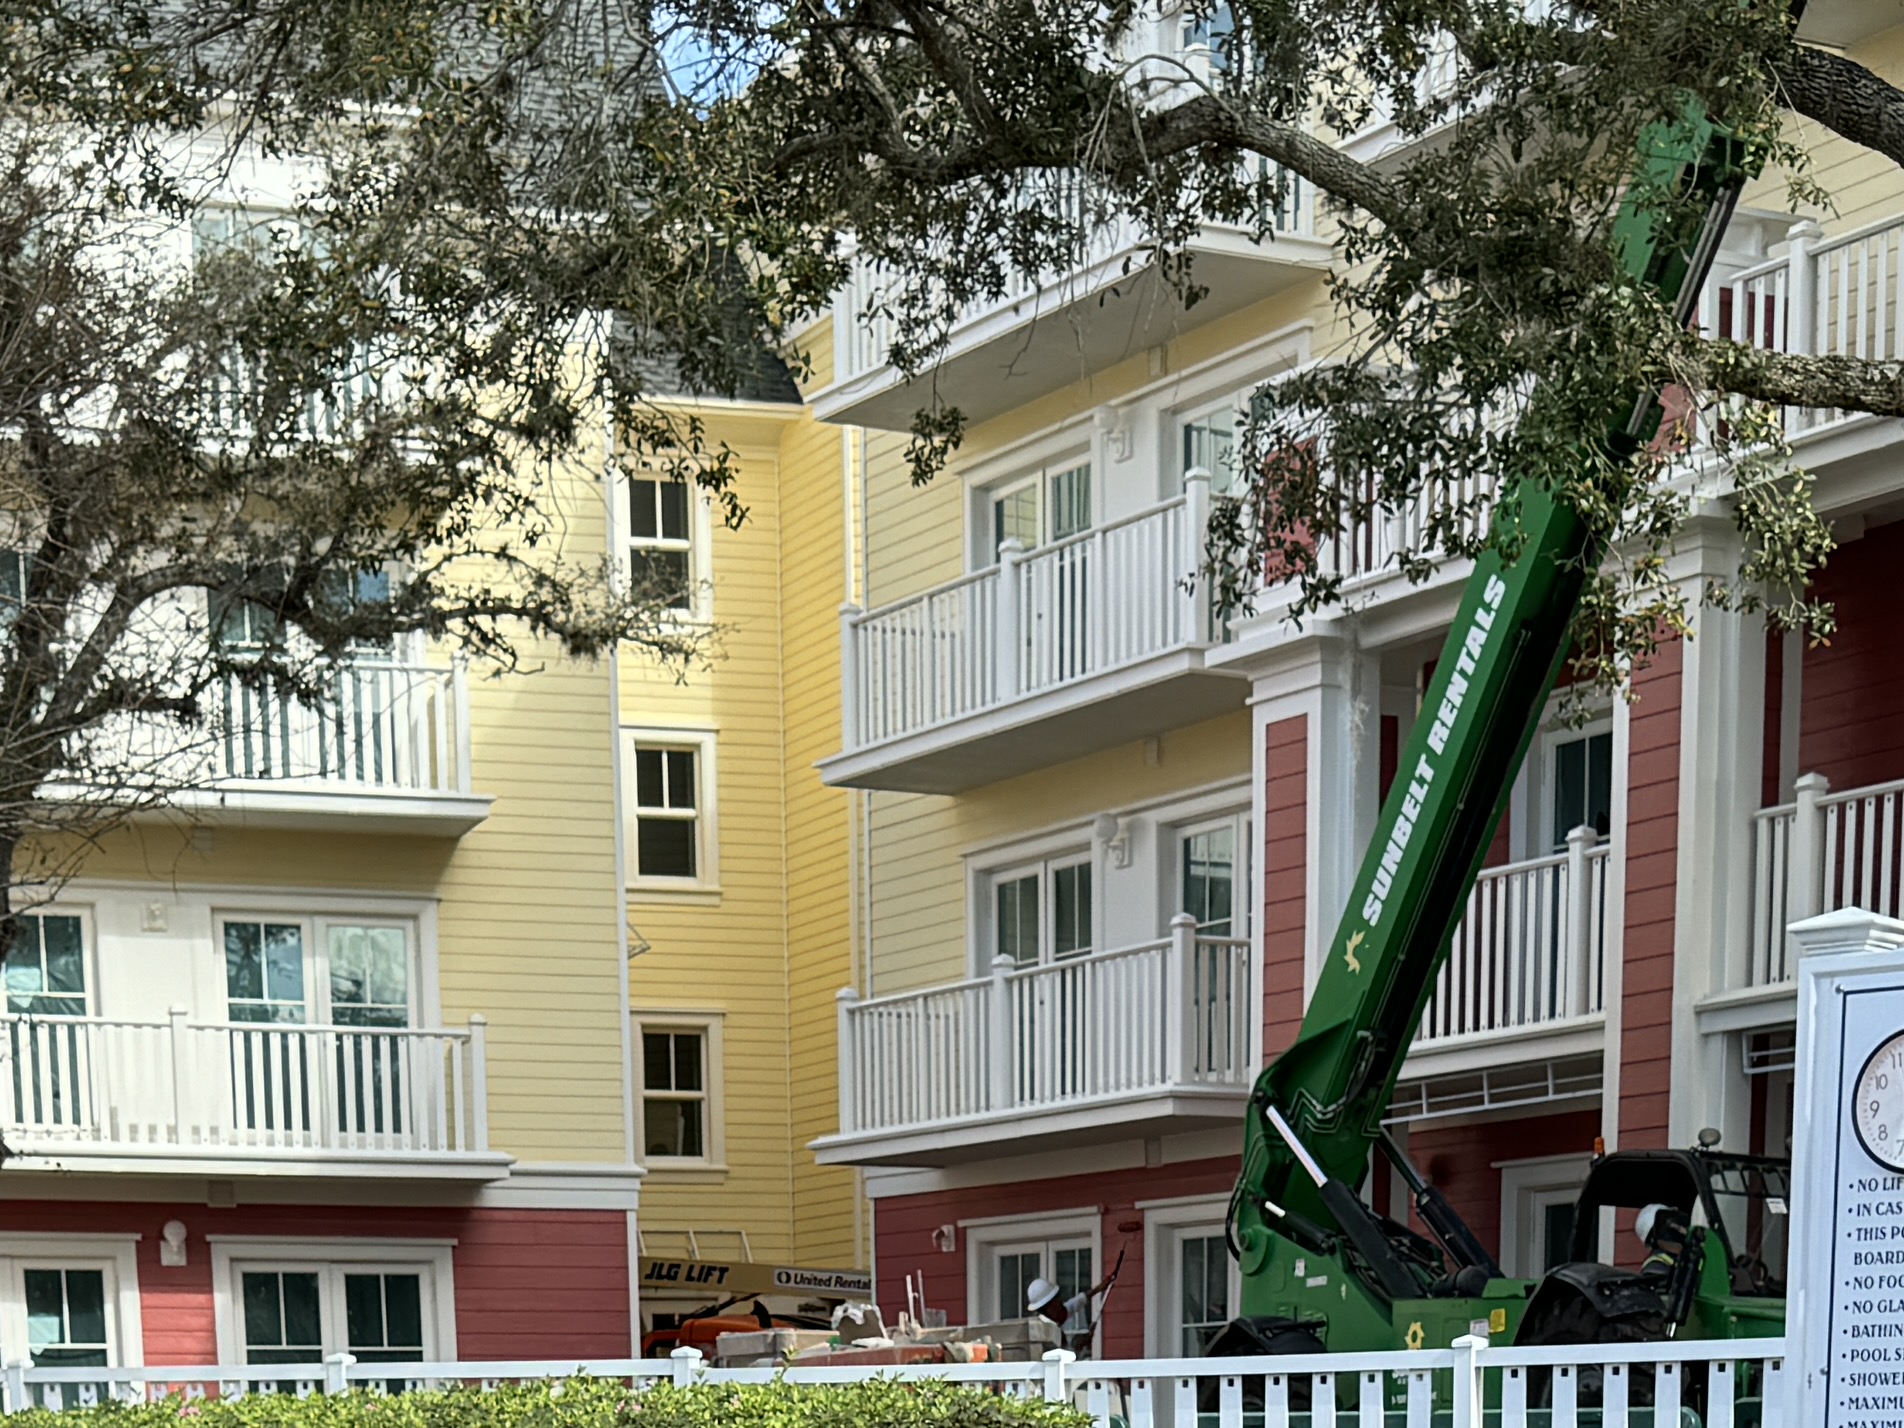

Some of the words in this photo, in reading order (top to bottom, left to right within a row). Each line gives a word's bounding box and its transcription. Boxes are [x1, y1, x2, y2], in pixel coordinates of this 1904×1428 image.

[1362, 754, 1435, 927] SUNBELT
[1426, 574, 1507, 756] RENTALS
[1891, 1051, 1903, 1069] 11
[1874, 1073, 1889, 1091] 10
[1869, 1100, 1880, 1119] 9
[1877, 1123, 1889, 1141] 8
[1857, 1177, 1880, 1193] NO
[1856, 1202, 1872, 1218] IN
[1855, 1226, 1887, 1242] THIS
[644, 1261, 682, 1281] JLG
[684, 1263, 730, 1284] LIFT
[793, 1272, 832, 1288] United
[1852, 1275, 1875, 1291] NO
[1852, 1299, 1874, 1315] NO
[1850, 1347, 1892, 1363] POOL
